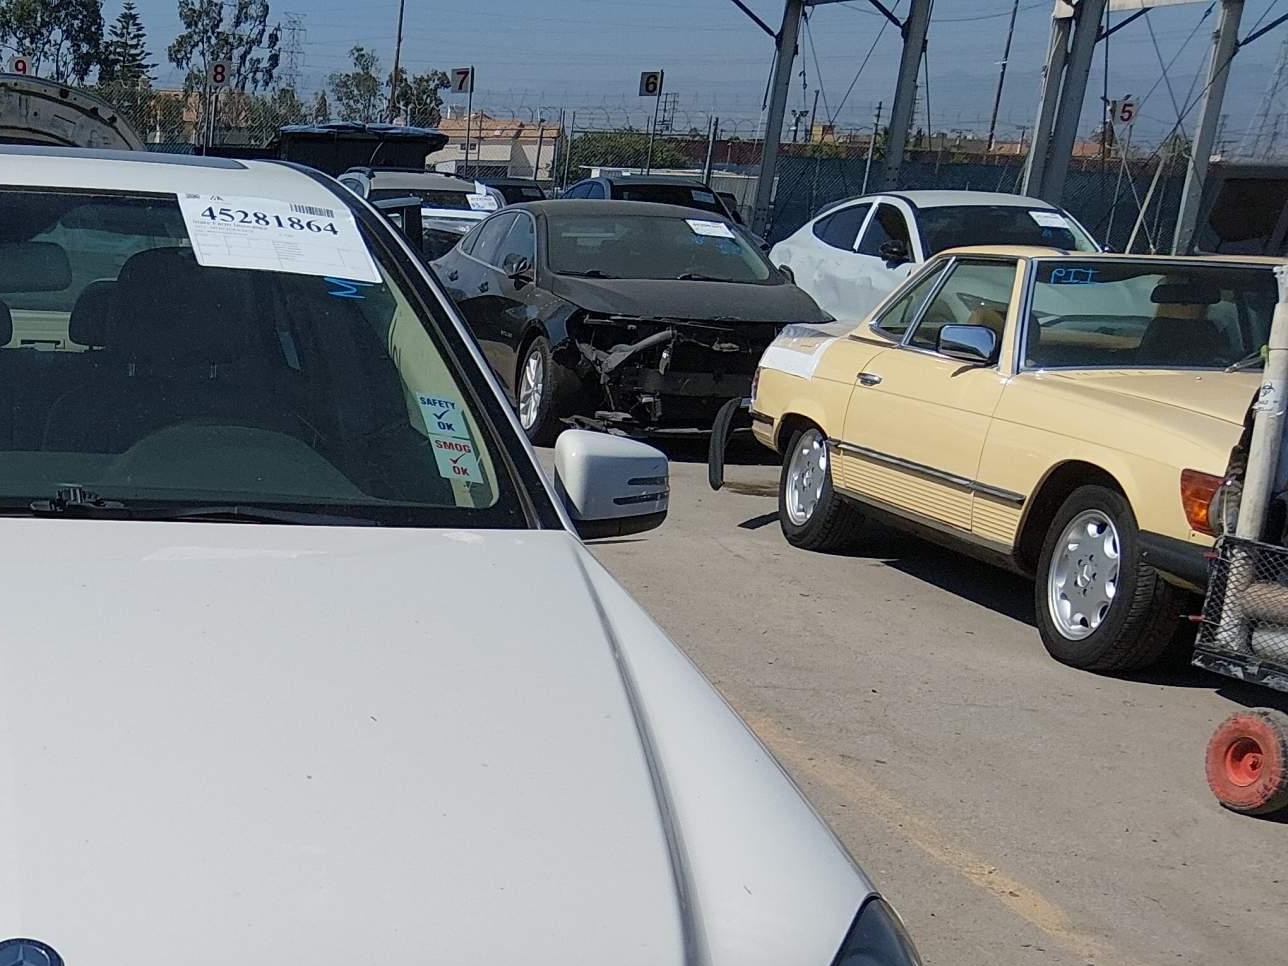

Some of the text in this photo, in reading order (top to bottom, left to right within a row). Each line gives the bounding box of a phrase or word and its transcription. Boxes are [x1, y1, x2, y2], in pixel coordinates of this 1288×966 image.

[15, 59, 27, 74] 9
[213, 64, 225, 83] 8
[456, 70, 469, 90] 7
[645, 75, 658, 93] 6
[1120, 103, 1133, 121] 5
[201, 206, 339, 236] 45281864
[419, 397, 456, 410] SAFETY
[437, 421, 456, 432] OK
[434, 439, 472, 453] SMOG
[452, 465, 470, 476] OK
